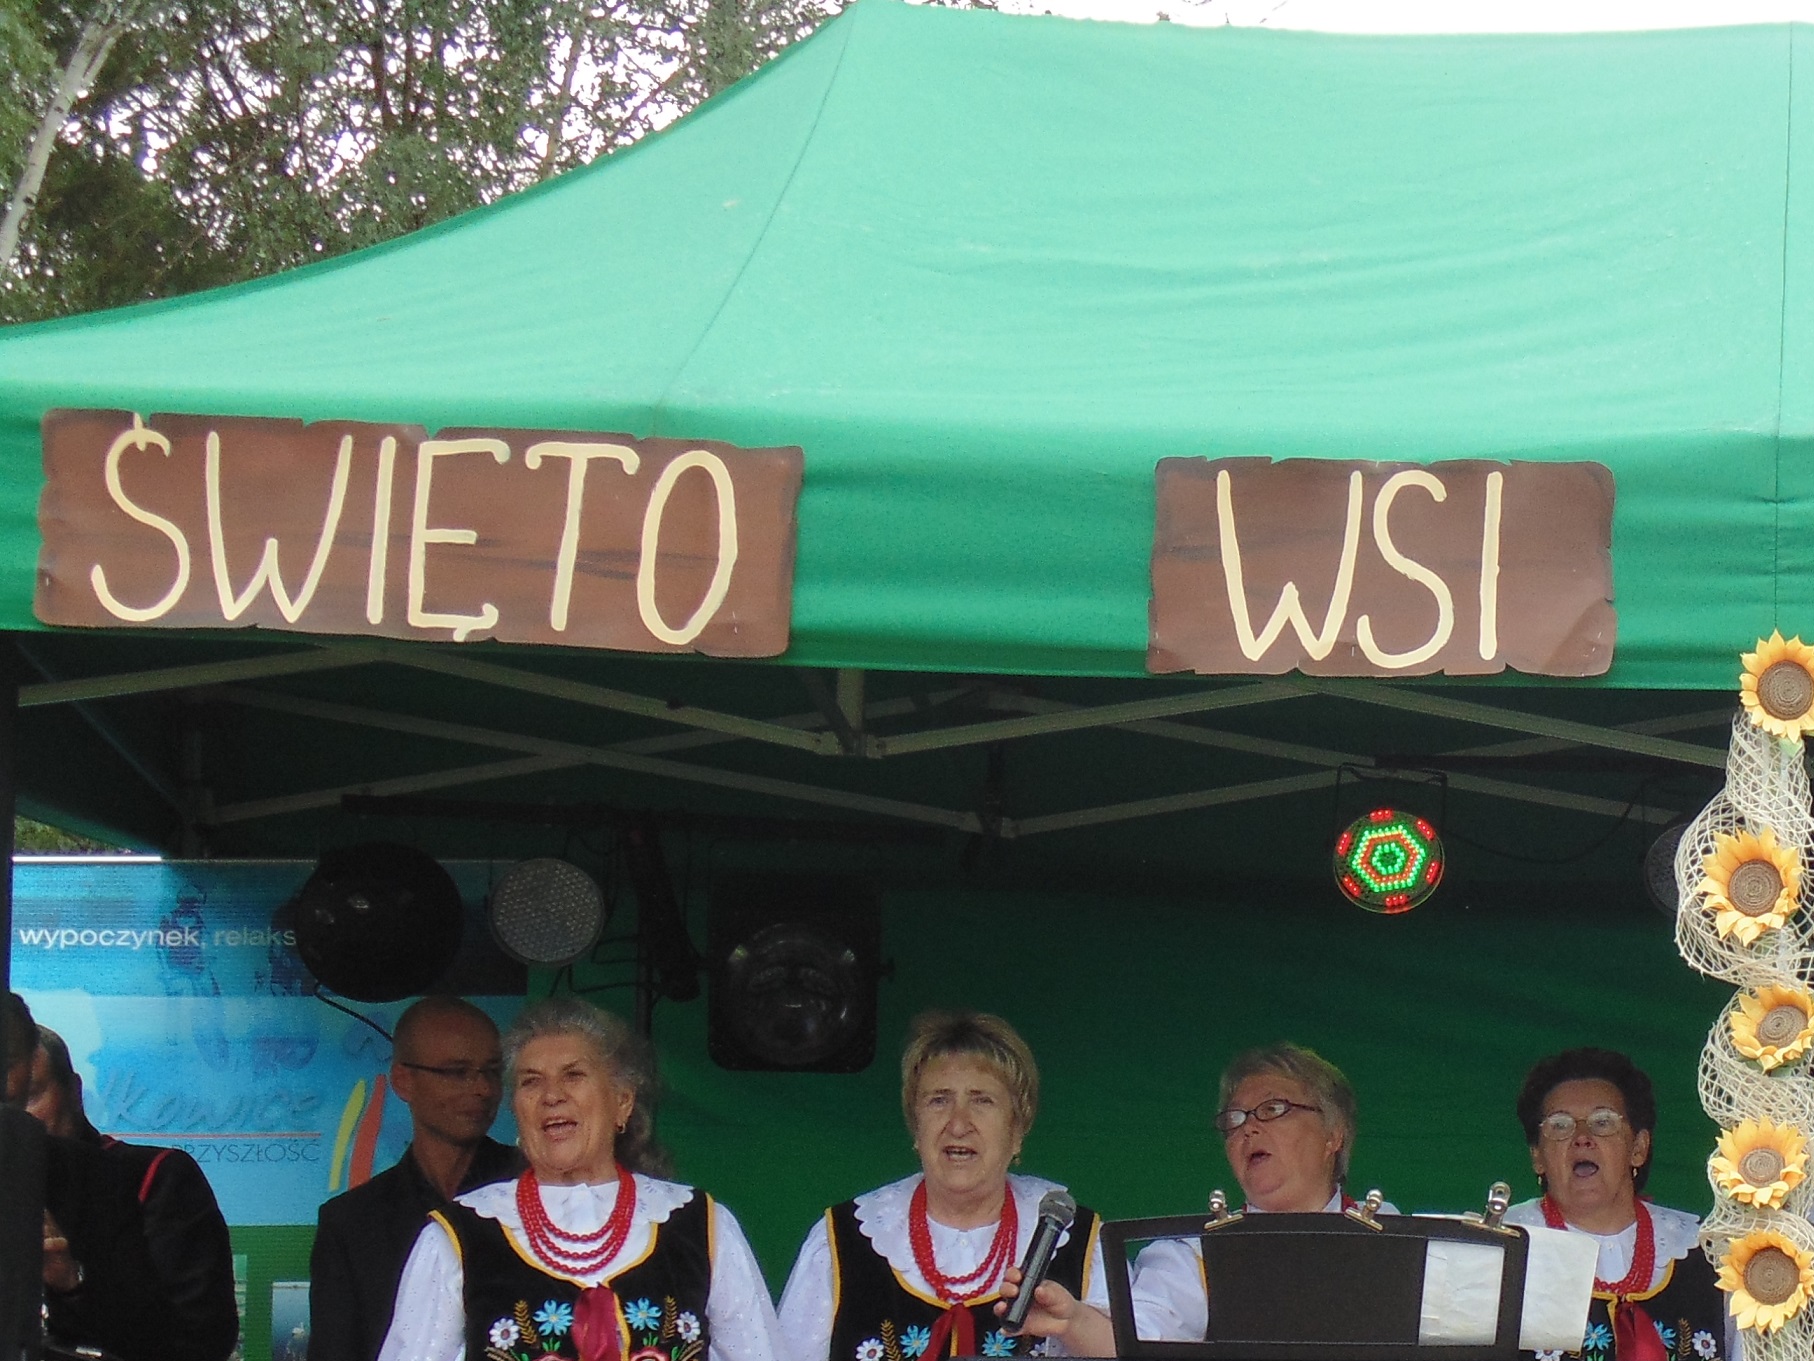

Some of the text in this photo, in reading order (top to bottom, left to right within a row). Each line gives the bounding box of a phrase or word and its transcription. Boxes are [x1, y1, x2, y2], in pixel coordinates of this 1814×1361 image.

[91, 413, 738, 646] ŚWIĘTO
[1216, 470, 1502, 668] WSI
[213, 926, 297, 946] relaks
